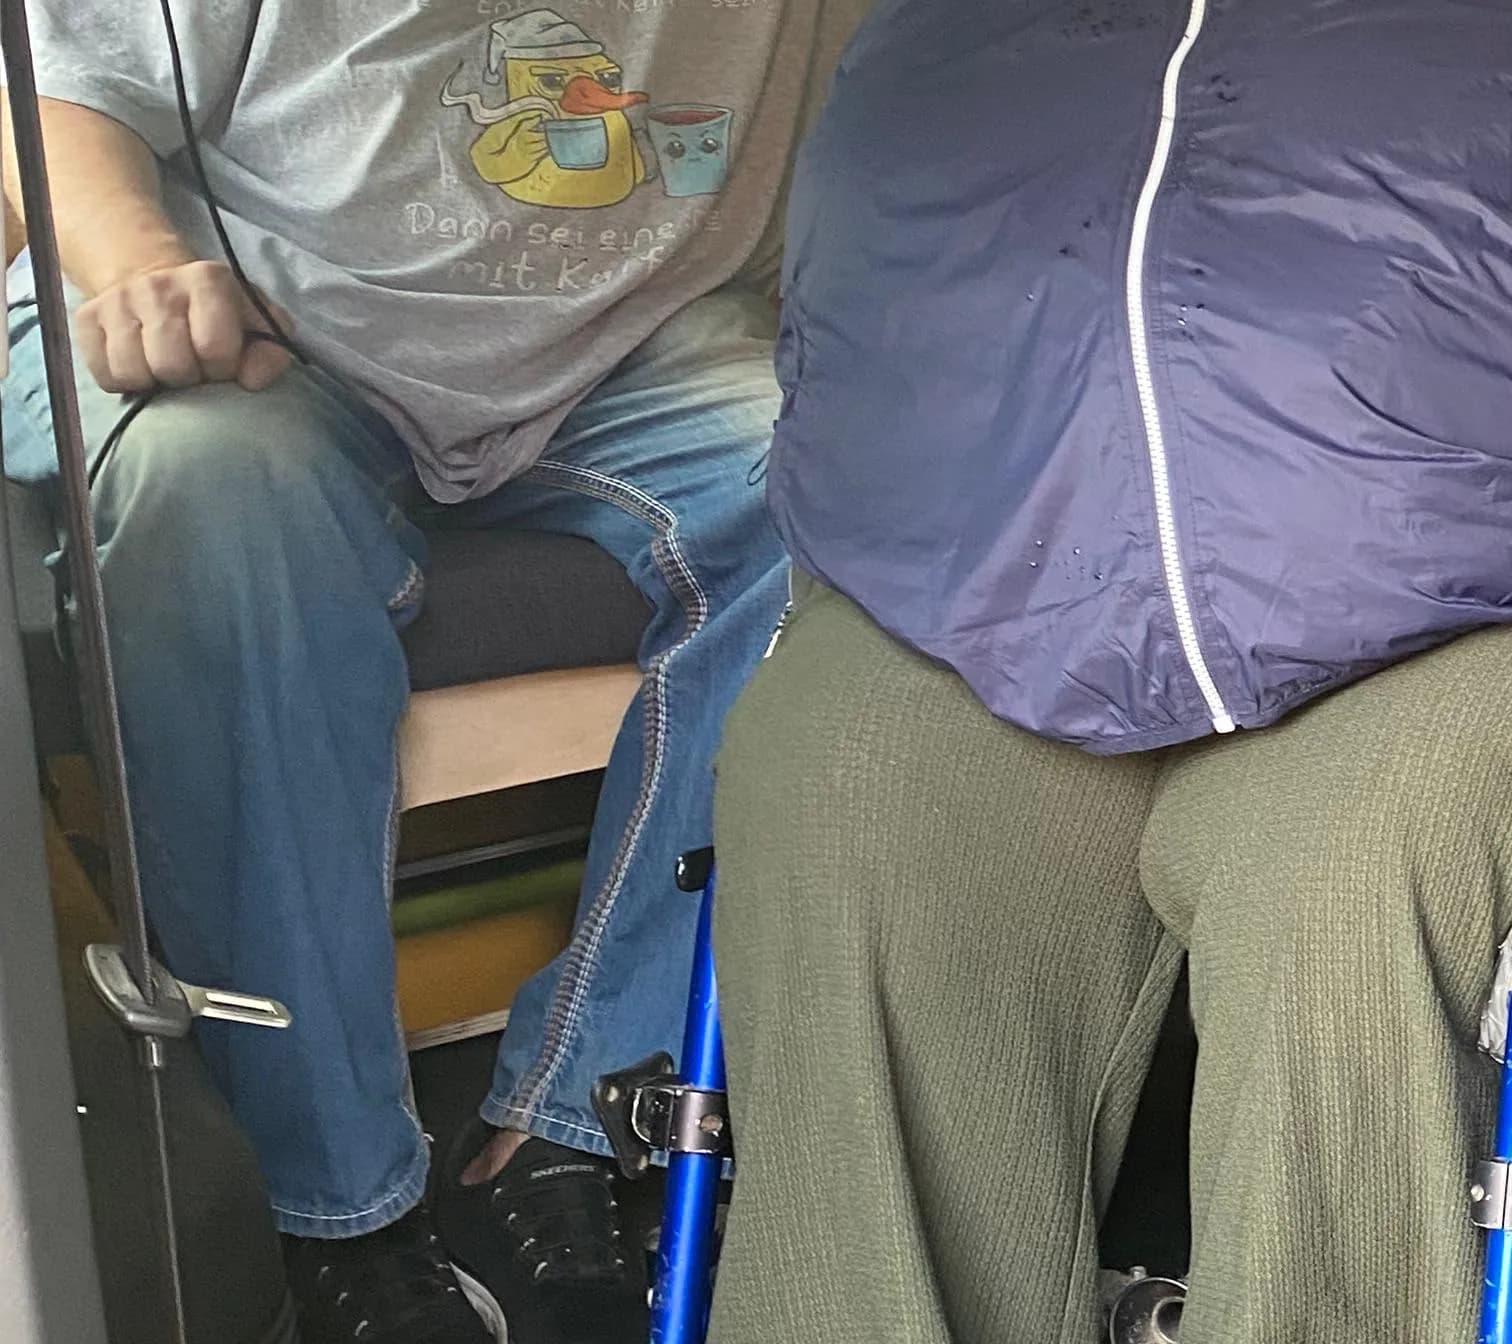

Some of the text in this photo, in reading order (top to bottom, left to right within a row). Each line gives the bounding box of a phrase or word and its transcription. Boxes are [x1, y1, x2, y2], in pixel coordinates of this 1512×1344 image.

[405, 202, 676, 251] Dann sei eine
[449, 251, 537, 291] mit
